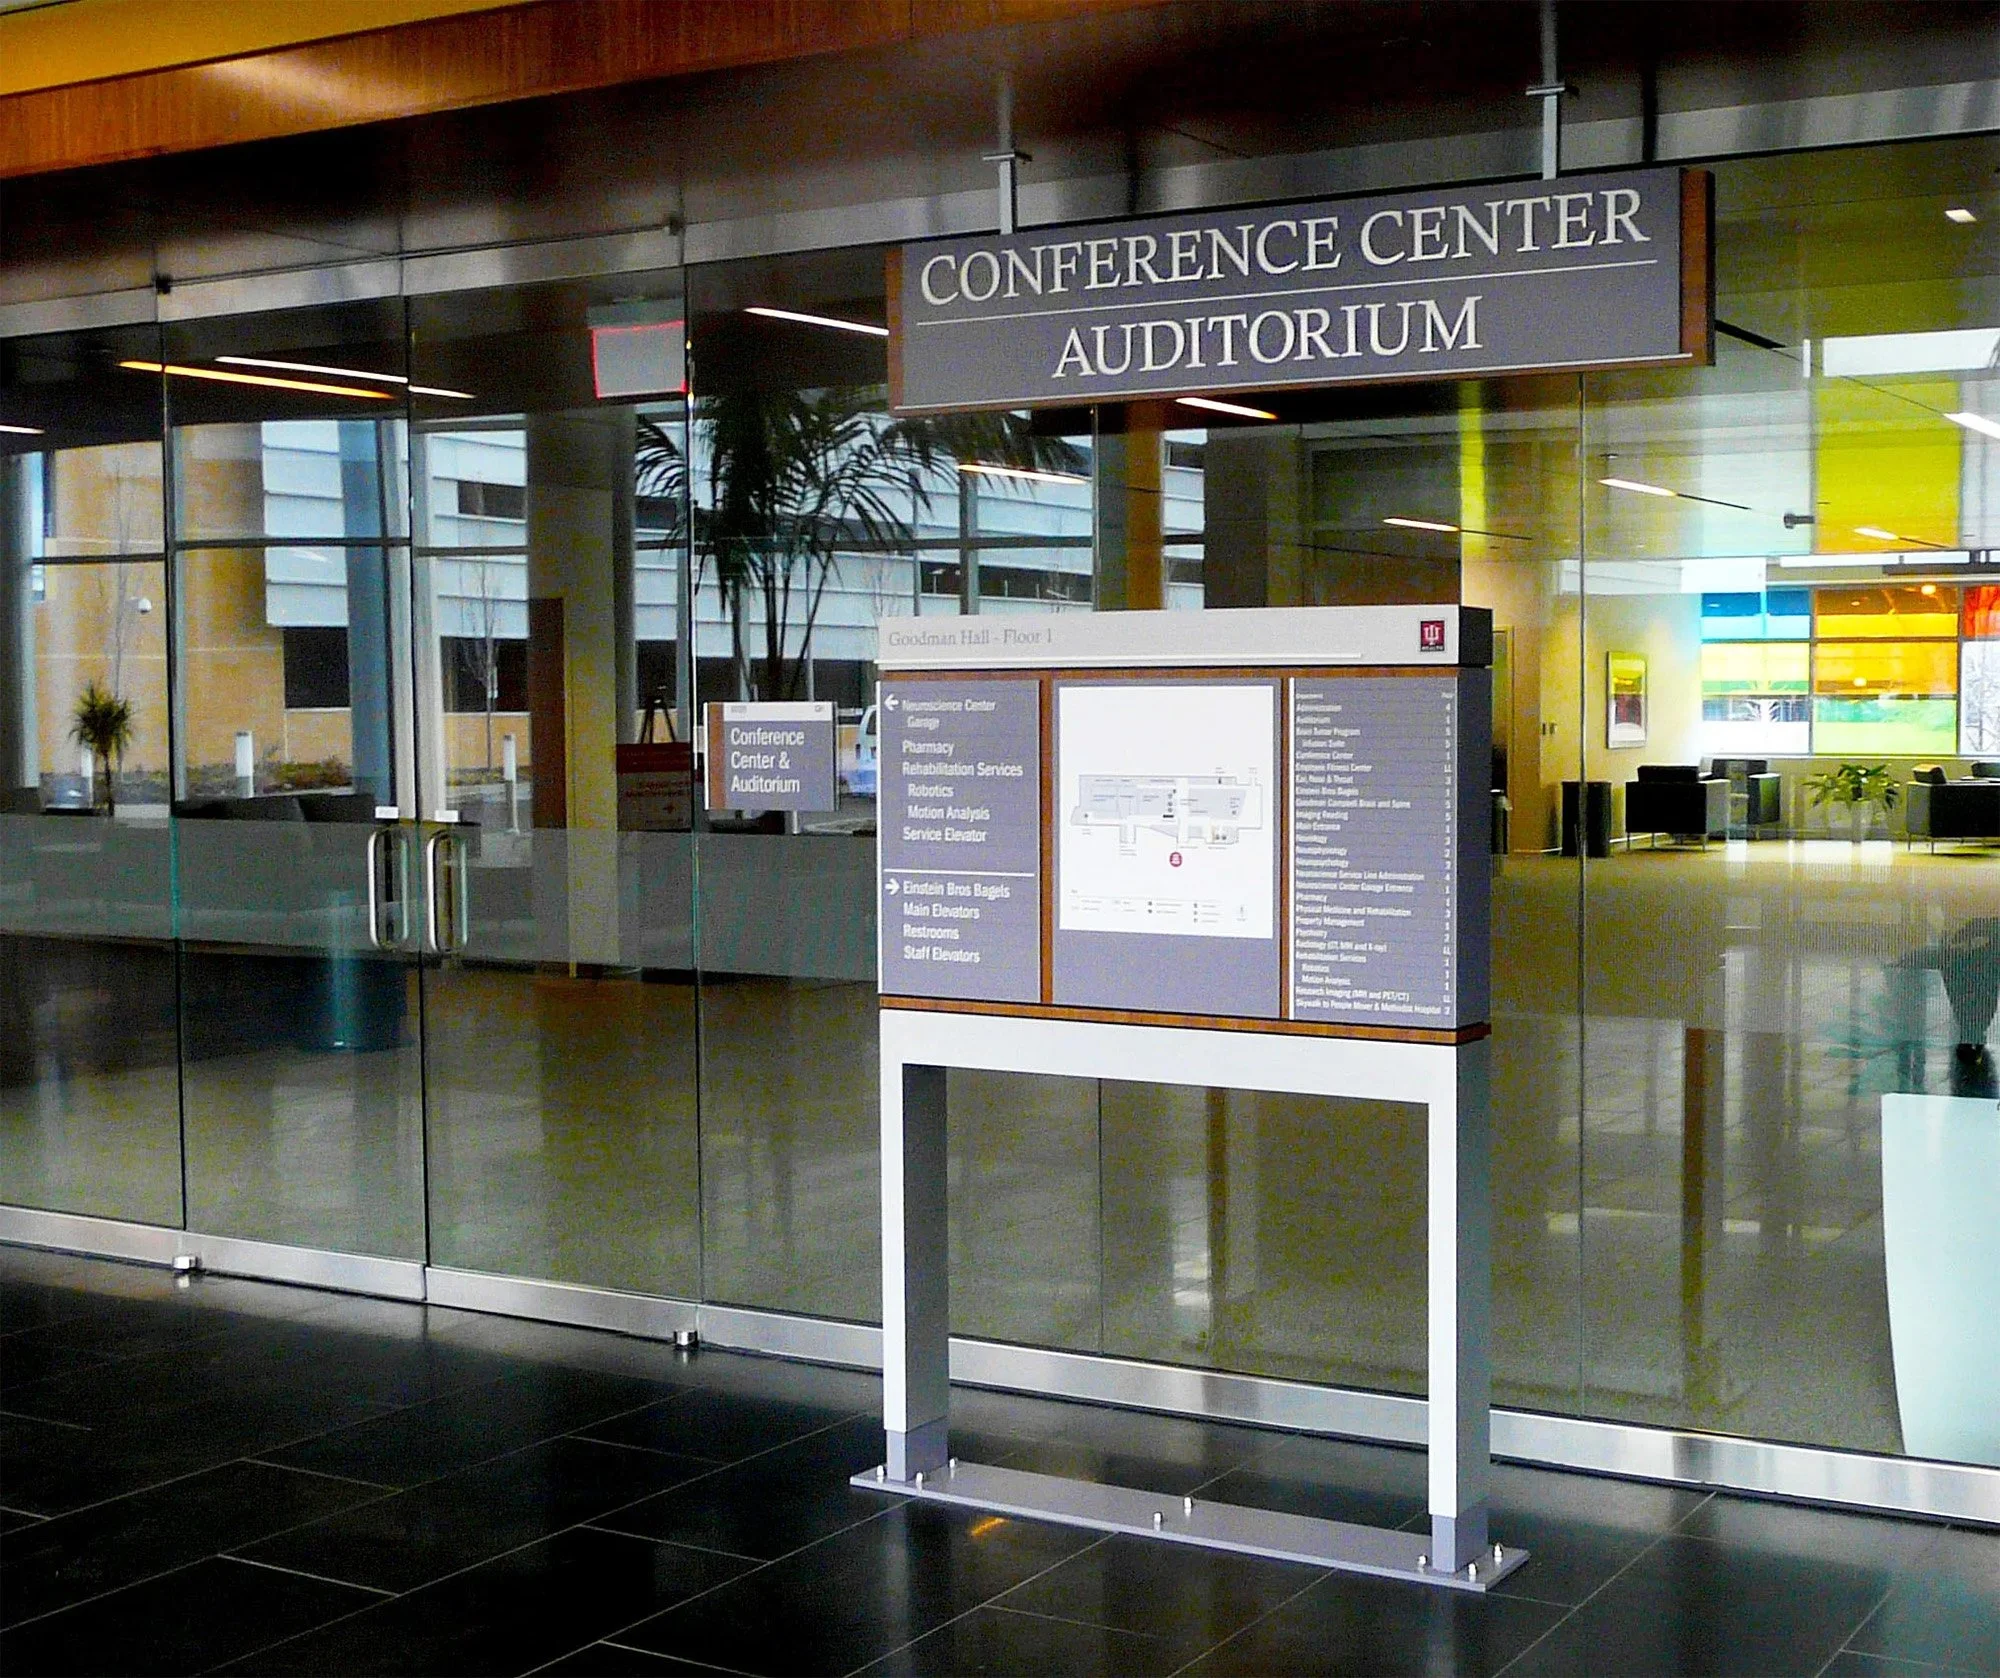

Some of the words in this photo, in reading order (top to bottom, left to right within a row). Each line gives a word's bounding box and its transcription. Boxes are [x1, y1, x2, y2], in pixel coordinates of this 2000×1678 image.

[920, 215, 1340, 306] CONFERENCE
[1359, 187, 1651, 266] CENTER
[1051, 295, 1483, 379] AUDITORIUM
[888, 631, 957, 647] Goodman
[960, 628, 990, 645] Hall
[1003, 627, 1042, 645] Floor
[902, 699, 963, 712] Neuroscience
[965, 699, 996, 712] Center
[907, 716, 940, 730] Garage
[730, 727, 805, 746] Conference
[902, 739, 954, 757] Pharmacy
[730, 751, 776, 770] Center
[778, 751, 791, 770] &
[902, 761, 975, 777] Rehabilitation
[976, 762, 1024, 777] Services
[730, 774, 801, 793] Auditorium
[908, 783, 954, 798] Robotics
[907, 804, 944, 820] Motion
[946, 805, 990, 823] Analysis
[902, 826, 942, 842] Service
[944, 827, 988, 843] Elevator
[902, 880, 945, 896] Einstein
[947, 882, 972, 897] Bros
[973, 882, 1011, 900] Bagels
[903, 902, 930, 917] Main
[932, 903, 980, 920] Elevators
[902, 923, 960, 940] Restrooms
[903, 945, 931, 961] Staff
[932, 946, 980, 963] Elevators
